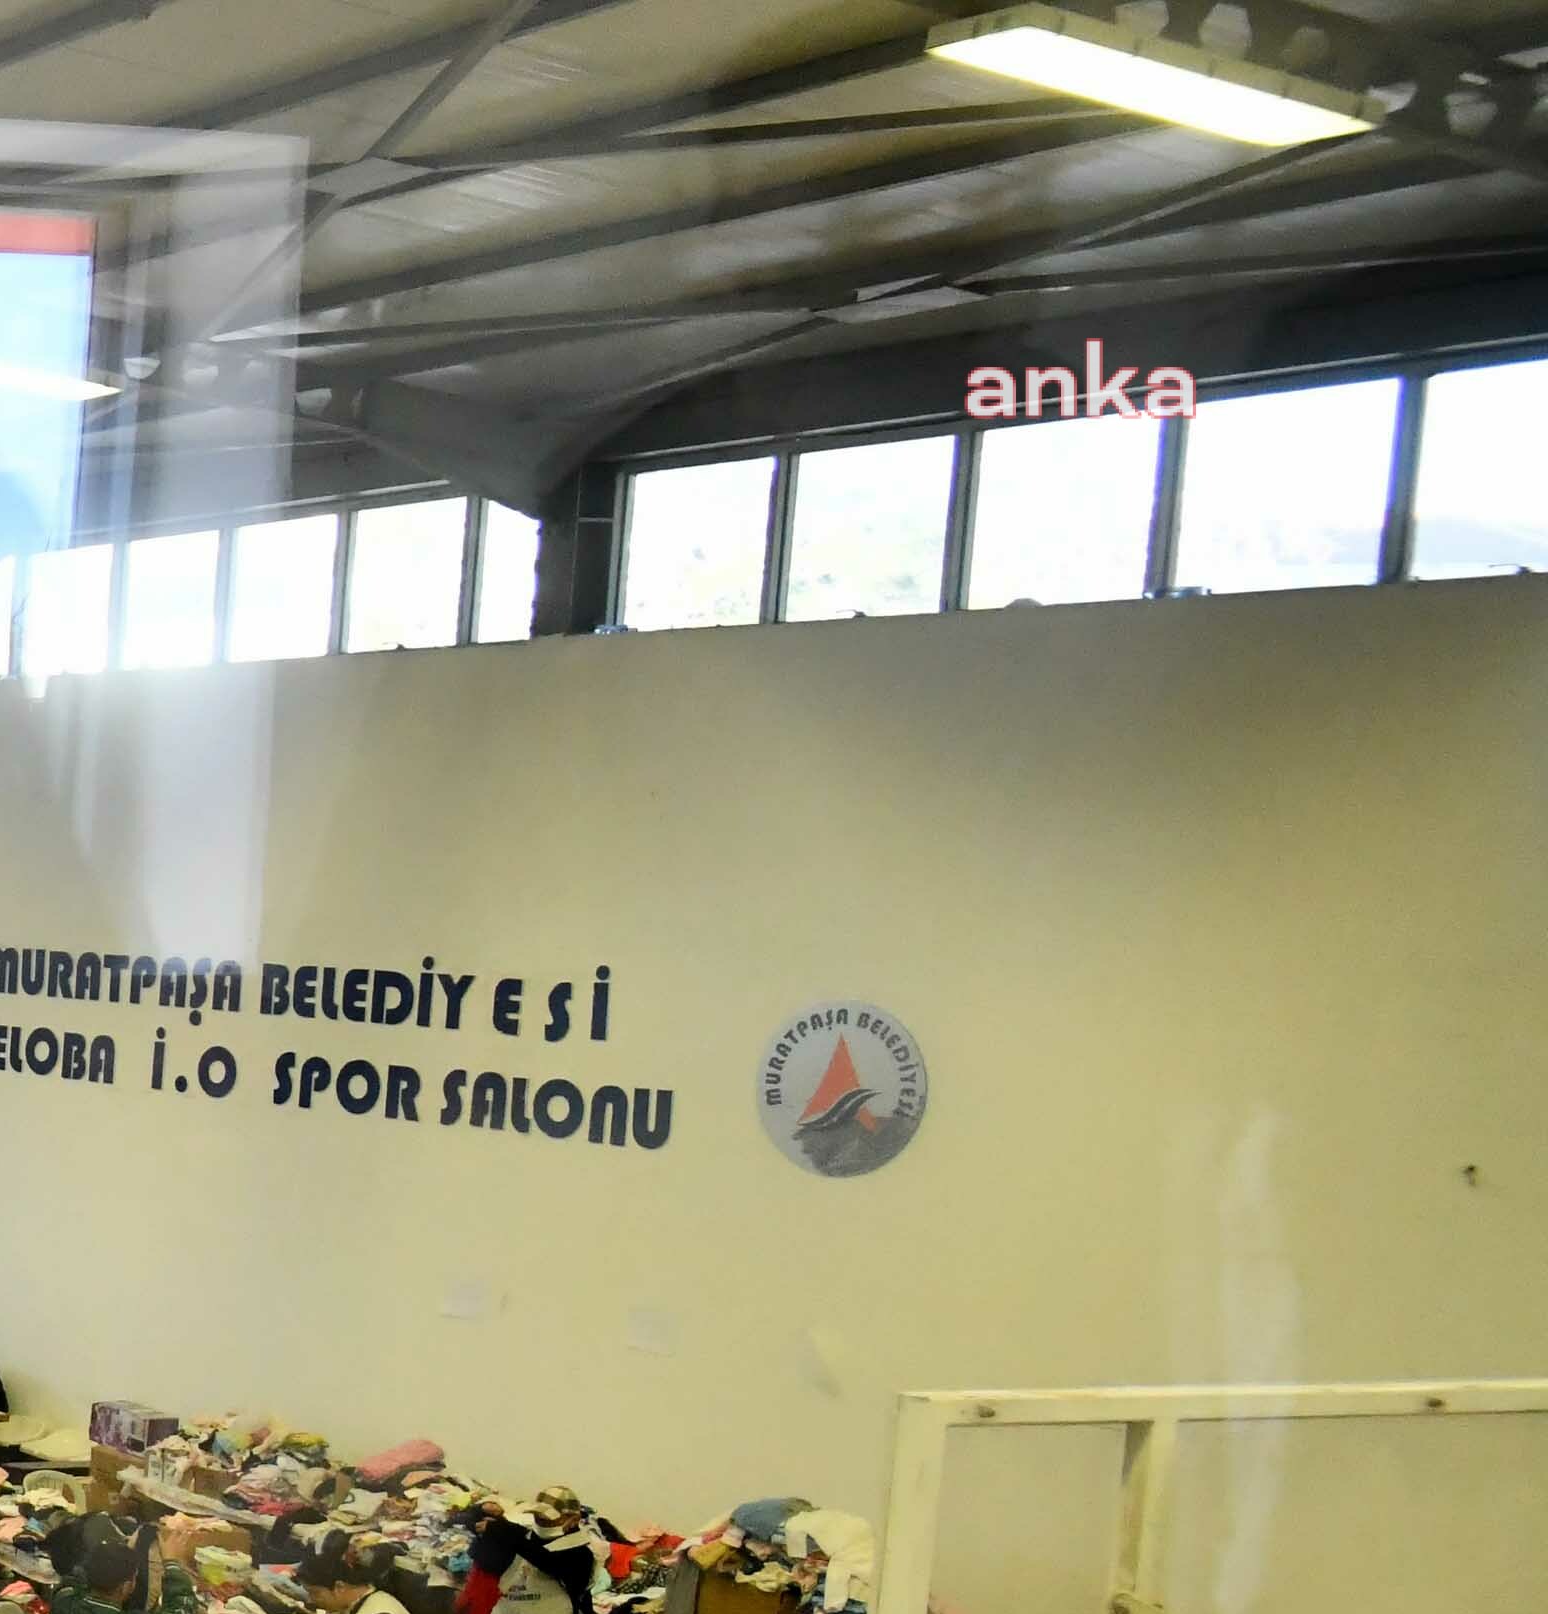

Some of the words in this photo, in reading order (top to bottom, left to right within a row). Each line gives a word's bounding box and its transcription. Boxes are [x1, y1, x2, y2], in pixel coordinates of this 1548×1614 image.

[272, 1052, 422, 1123] SPOR
[439, 1068, 674, 1151] SALONU
[764, 1006, 850, 1108] MURATPAŞA
[855, 1011, 922, 1122] BELEDİYESİ
